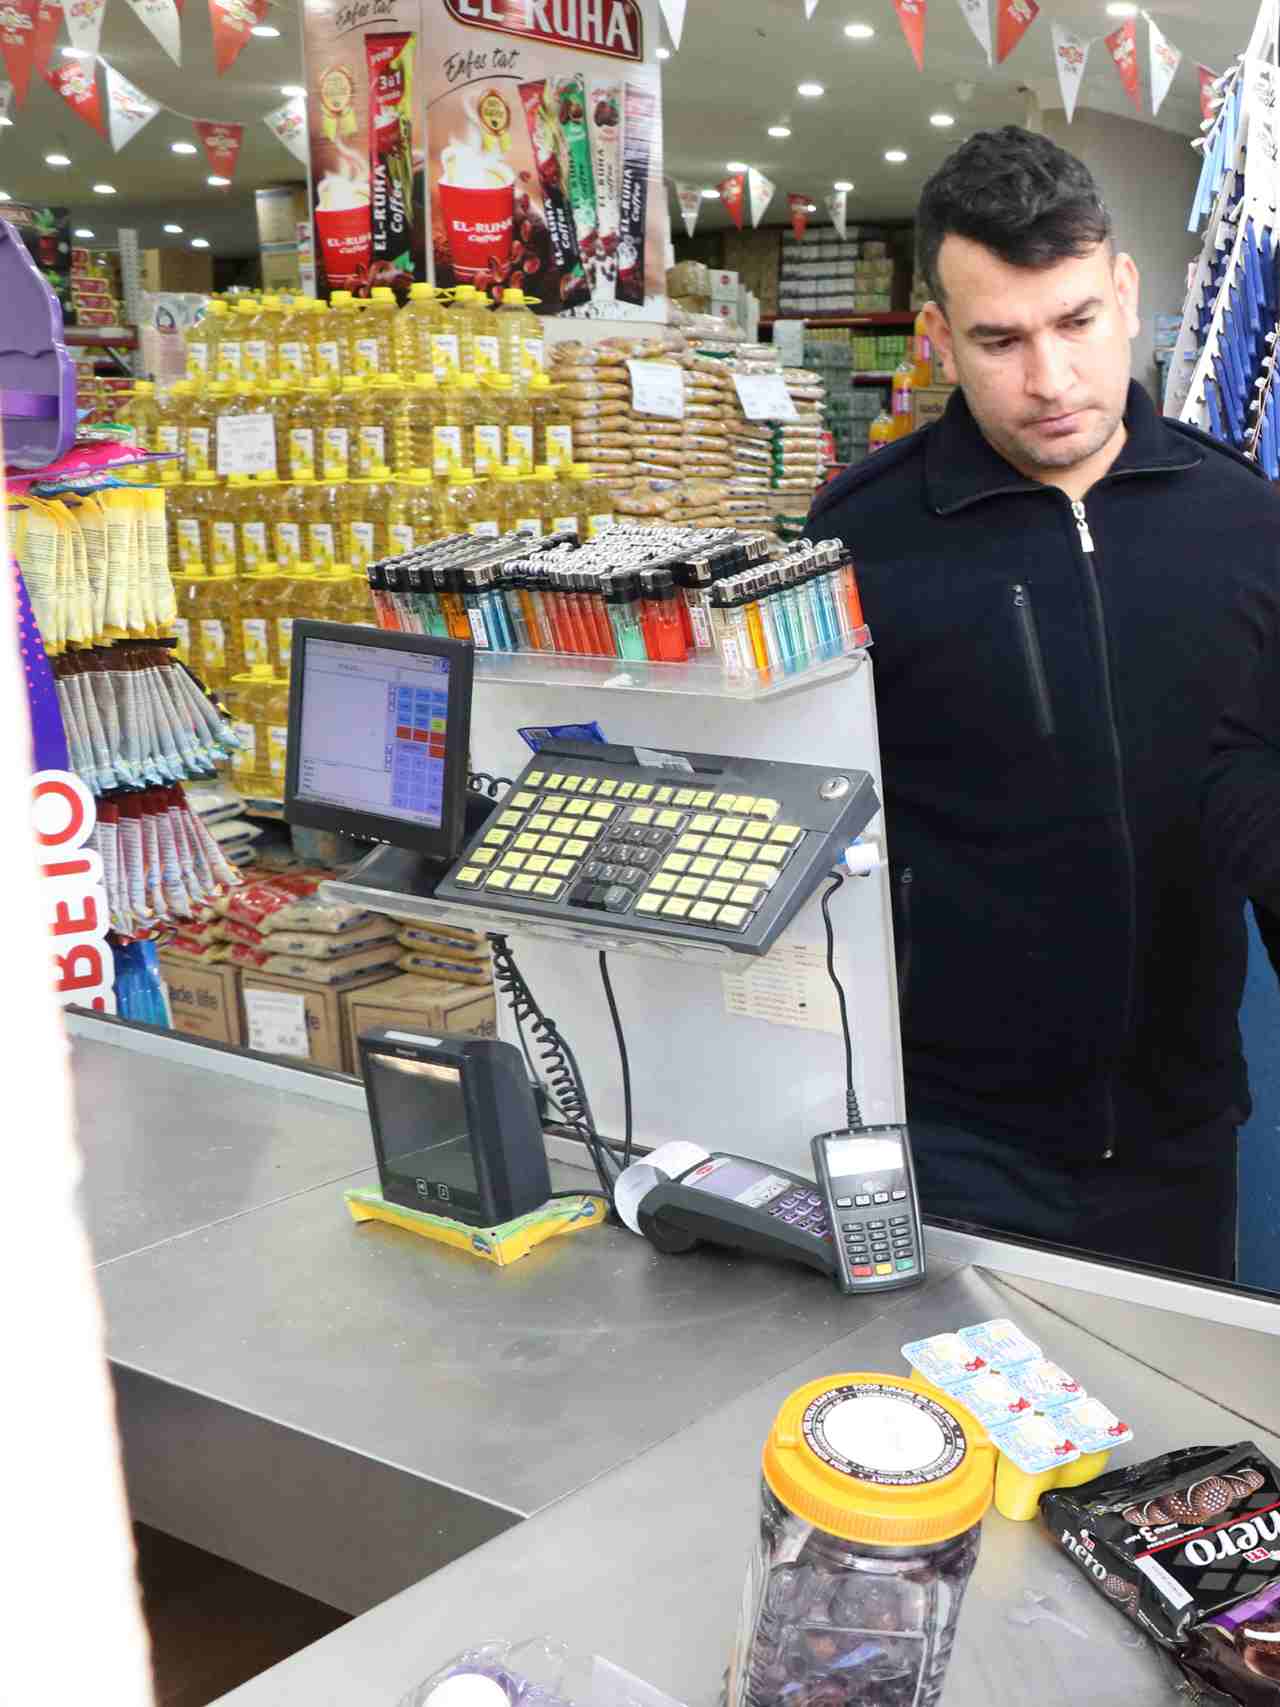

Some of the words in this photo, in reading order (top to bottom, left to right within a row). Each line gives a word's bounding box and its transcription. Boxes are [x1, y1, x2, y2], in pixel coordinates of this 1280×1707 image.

[373, 164, 387, 250] EL-RUHA
[389, 179, 406, 233] Coffee
[620, 167, 632, 232] EL-RUHA
[631, 181, 641, 222] Coffee
[544, 198, 564, 266] EL-RUHA
[556, 208, 570, 249] Coffee
[1062, 1529, 1107, 1580] nero
